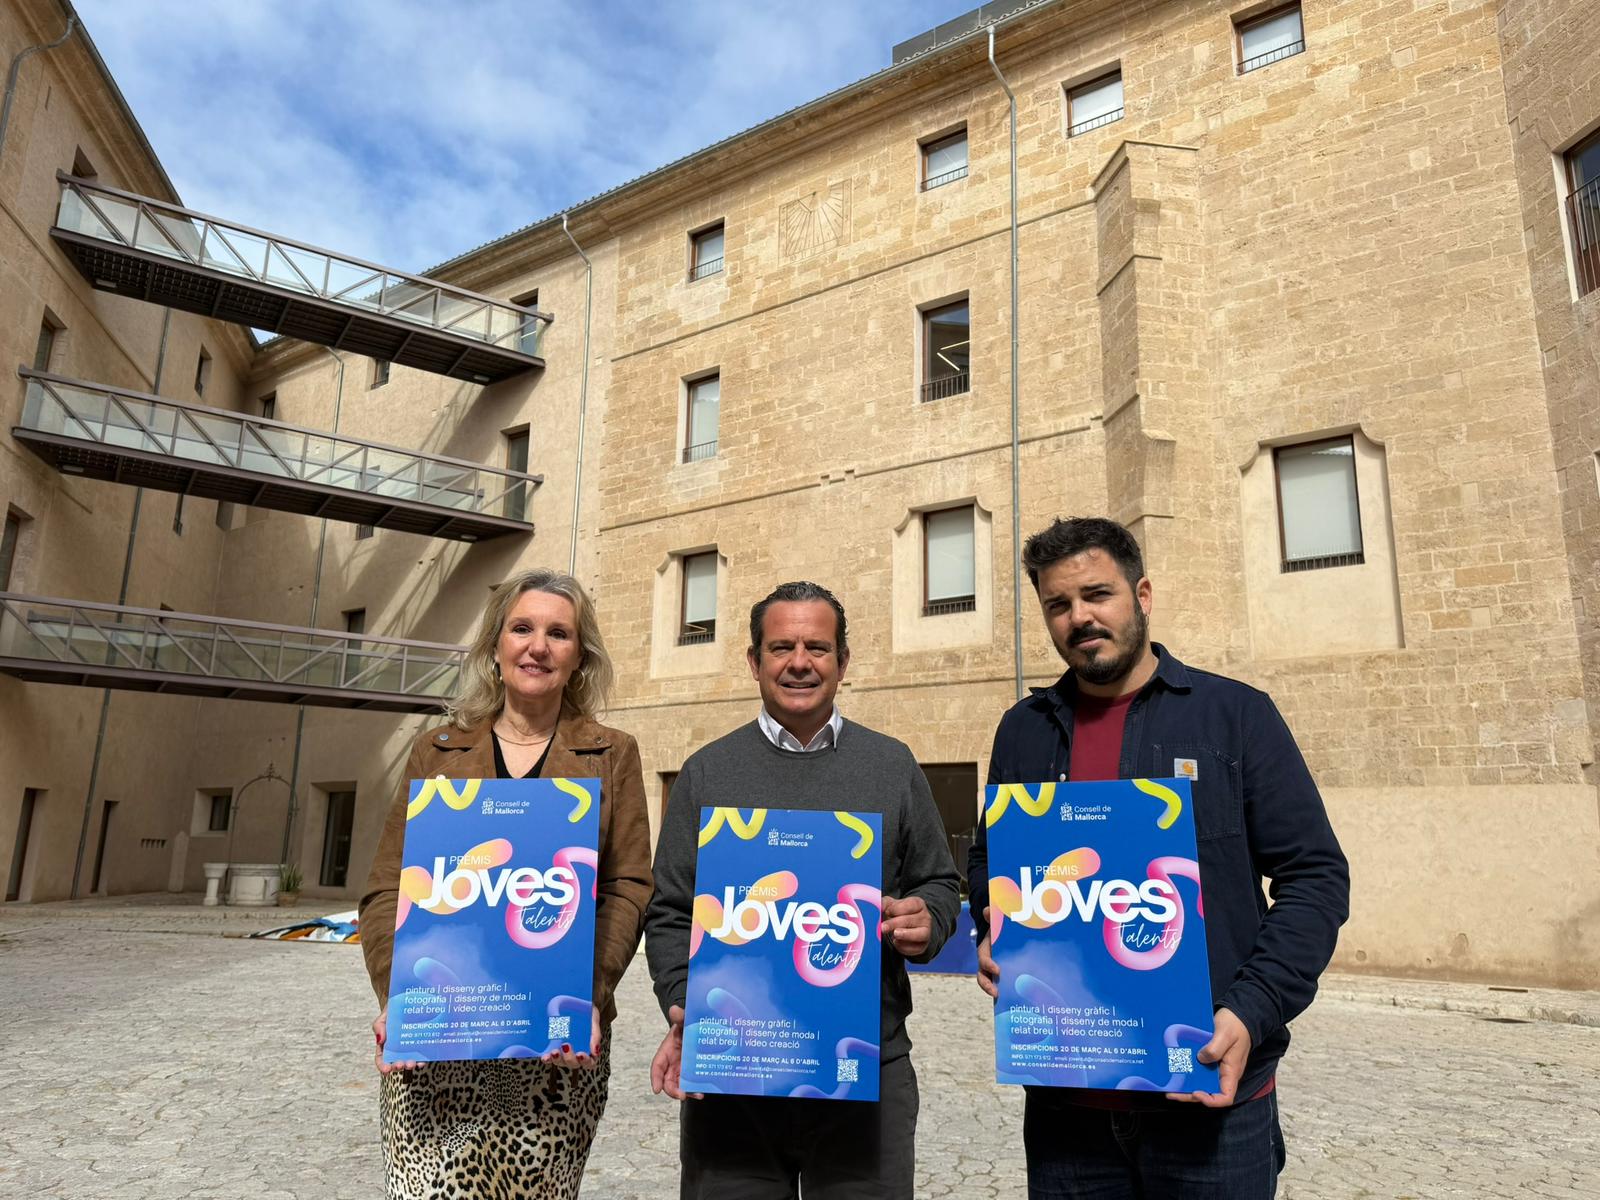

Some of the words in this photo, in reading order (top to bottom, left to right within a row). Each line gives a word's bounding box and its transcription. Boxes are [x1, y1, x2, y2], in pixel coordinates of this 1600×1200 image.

[495, 800, 520, 808] Consell
[1074, 806, 1100, 814] Consell
[450, 856, 491, 866] PREMIS
[1036, 865, 1079, 876] PREMIS
[418, 856, 574, 908] Joves
[739, 886, 778, 896] PREMIS
[1010, 866, 1177, 924] Joves
[710, 886, 860, 944] Joves
[405, 986, 435, 995] pintura
[442, 984, 475, 994] disseny
[478, 984, 502, 994] gràfic
[404, 996, 446, 1006] fotografia
[454, 995, 486, 1004] disseny
[404, 1006, 424, 1014] relat
[426, 1005, 446, 1014] breu
[478, 1003, 510, 1012] creació
[1010, 1005, 1040, 1014] pintura
[1048, 1006, 1081, 1016] disseny
[1084, 1006, 1110, 1016] gràfic
[700, 1017, 728, 1026] pintura
[734, 1018, 766, 1028] disseny
[768, 1020, 790, 1029] gràfic
[1010, 1015, 1053, 1026] fotografia
[1061, 1017, 1096, 1027] disseny
[1098, 1018, 1110, 1026] de
[1112, 1018, 1138, 1026] moda
[698, 1026, 738, 1036] fotografia
[746, 1029, 776, 1039] disseny
[778, 1030, 790, 1038] de
[792, 1031, 814, 1039] moda
[1011, 1026, 1031, 1034] relat
[1033, 1026, 1054, 1035] breu
[1088, 1028, 1122, 1038] creació
[698, 1036, 717, 1045] relat
[719, 1038, 738, 1046] breu
[769, 1040, 800, 1048] creació
[696, 1054, 740, 1062] INSCRIPCIONS
[1012, 1062, 1096, 1070] www.conselldemallorca.es
